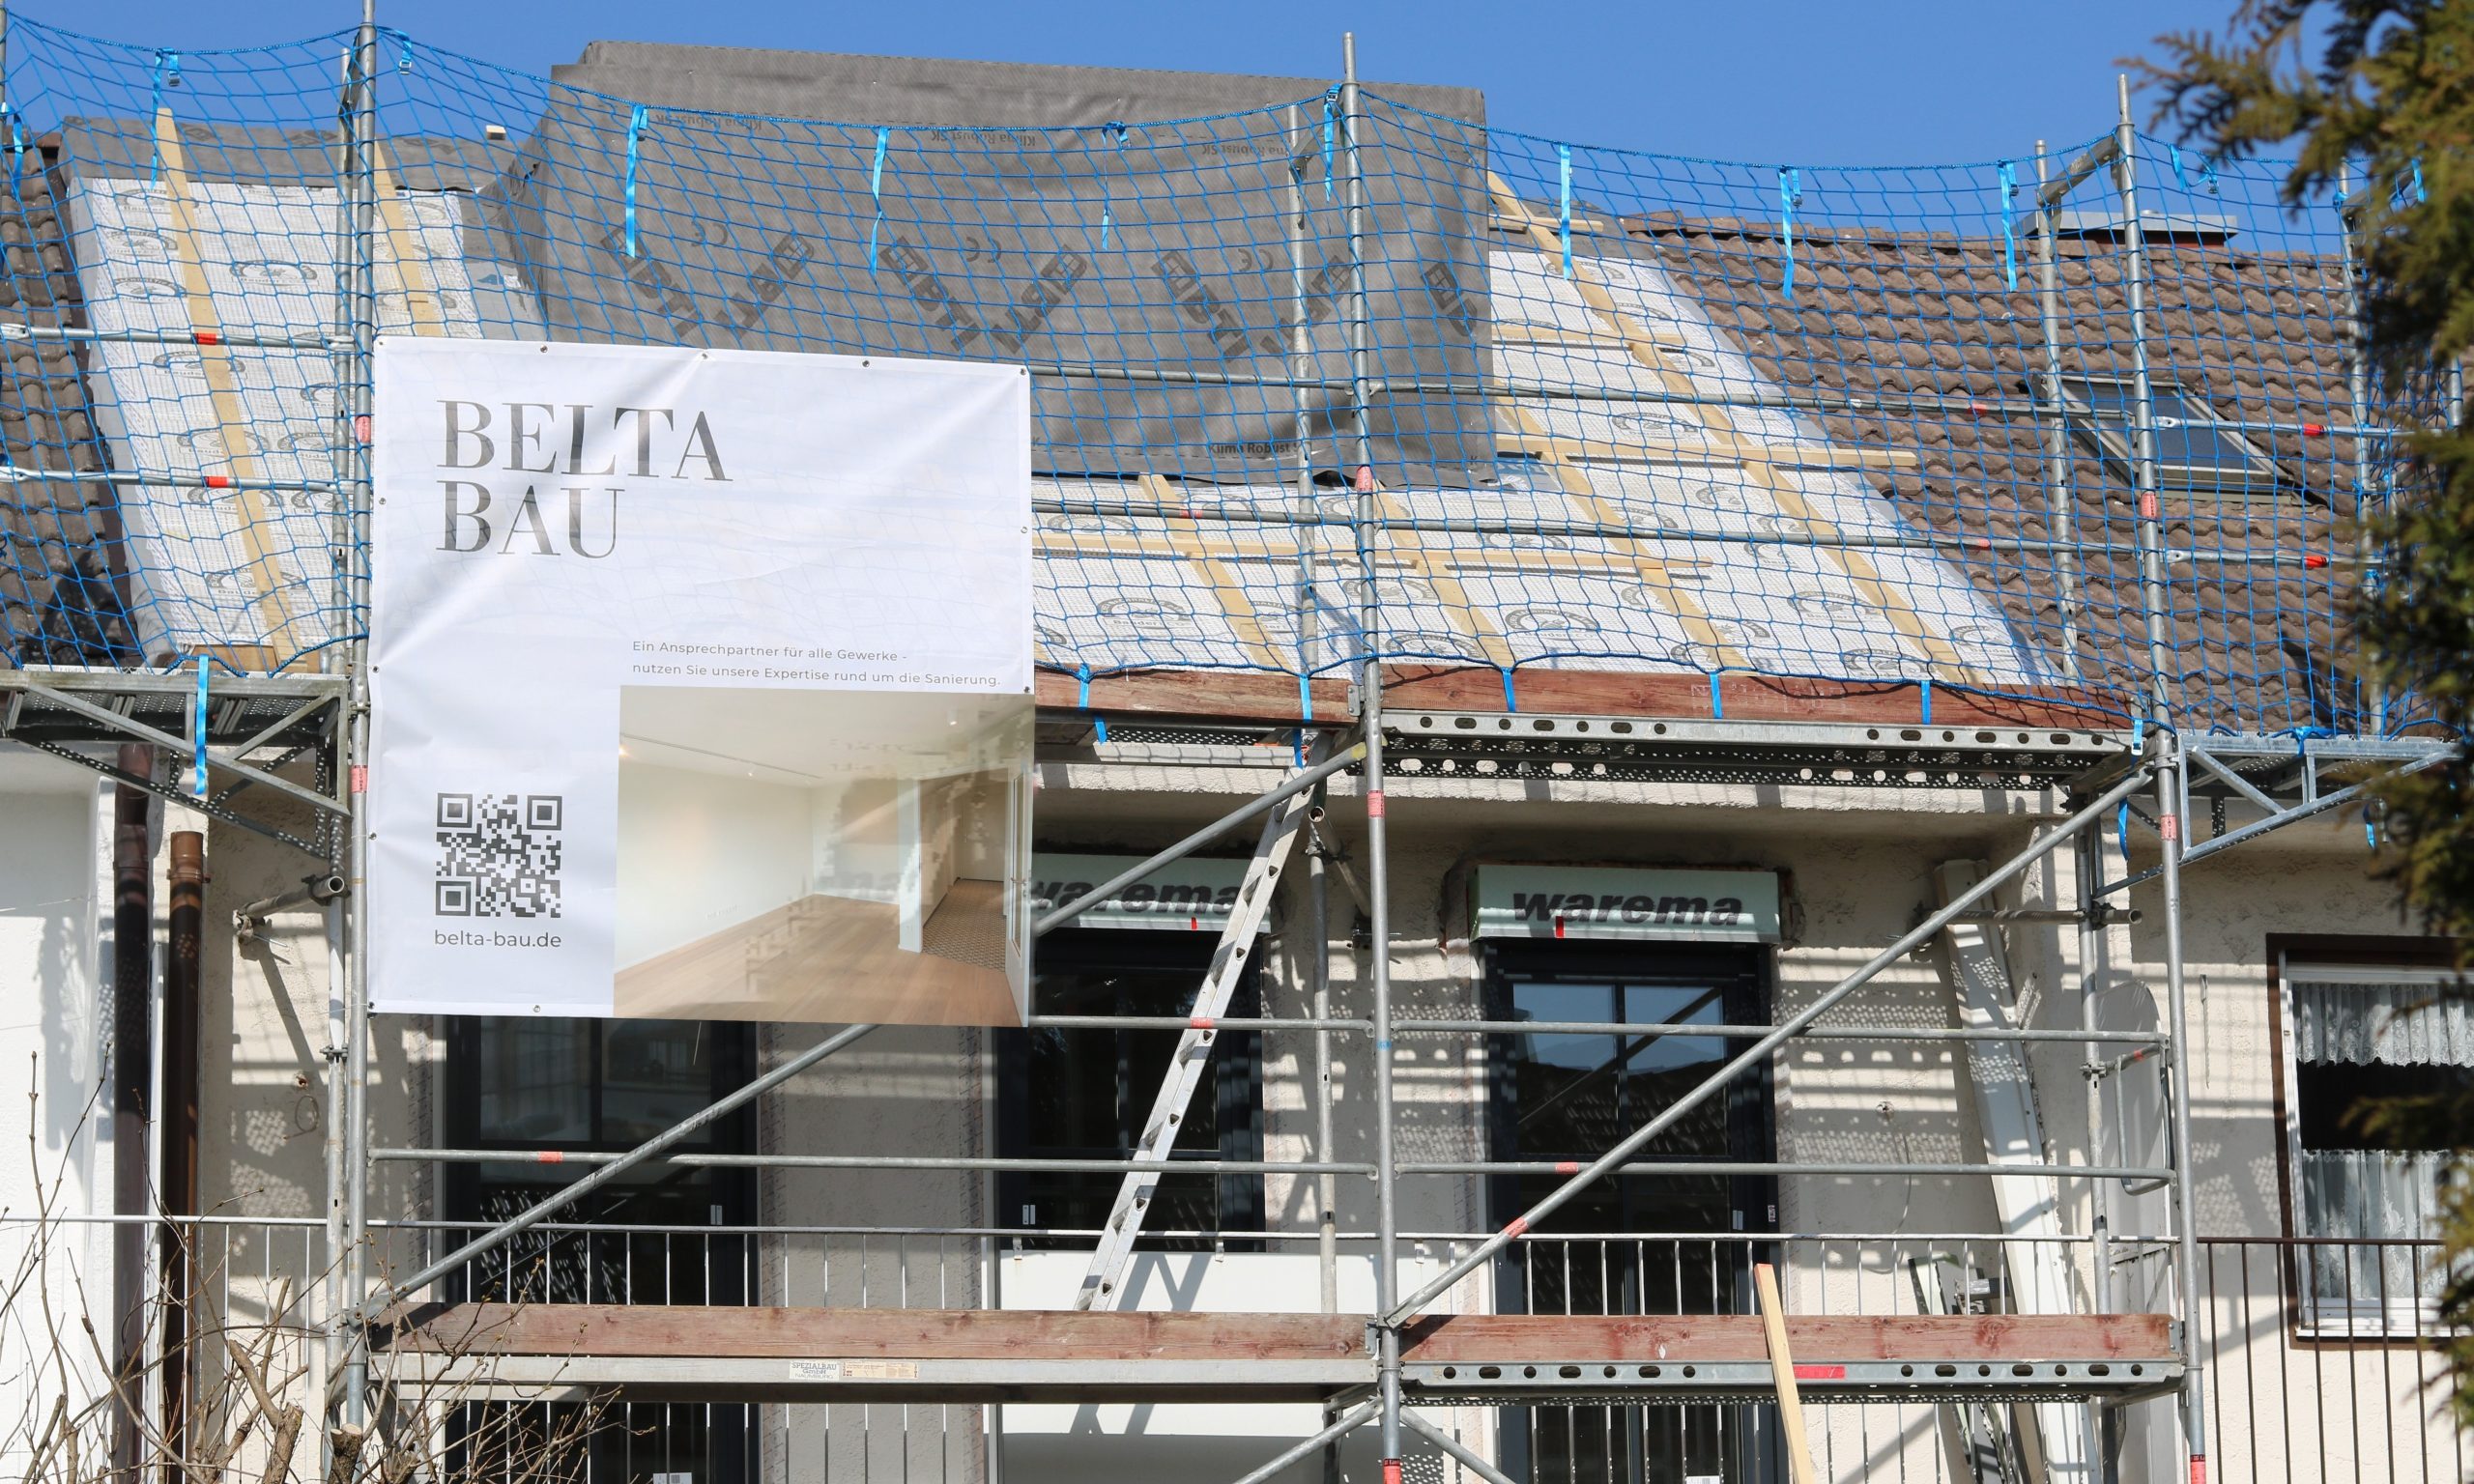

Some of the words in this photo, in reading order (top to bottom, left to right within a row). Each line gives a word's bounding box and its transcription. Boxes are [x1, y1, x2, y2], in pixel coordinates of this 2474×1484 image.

[437, 400, 734, 481] BELTA
[436, 480, 625, 558] BAU
[633, 641, 654, 651] Ein
[659, 642, 780, 656] Ansprechpartner
[784, 646, 803, 658] für
[808, 647, 833, 659] alle
[837, 649, 898, 662] Gewerke
[633, 664, 682, 674] nutzen
[686, 665, 707, 675] Sie
[712, 668, 760, 677] unsere
[764, 668, 830, 680] Expertise
[834, 671, 867, 682] rund
[872, 673, 894, 682] um
[899, 672, 921, 683] die
[925, 673, 1001, 687] Sanierung.
[1512, 892, 1743, 928] warema
[435, 929, 561, 948] belta-bau.de
